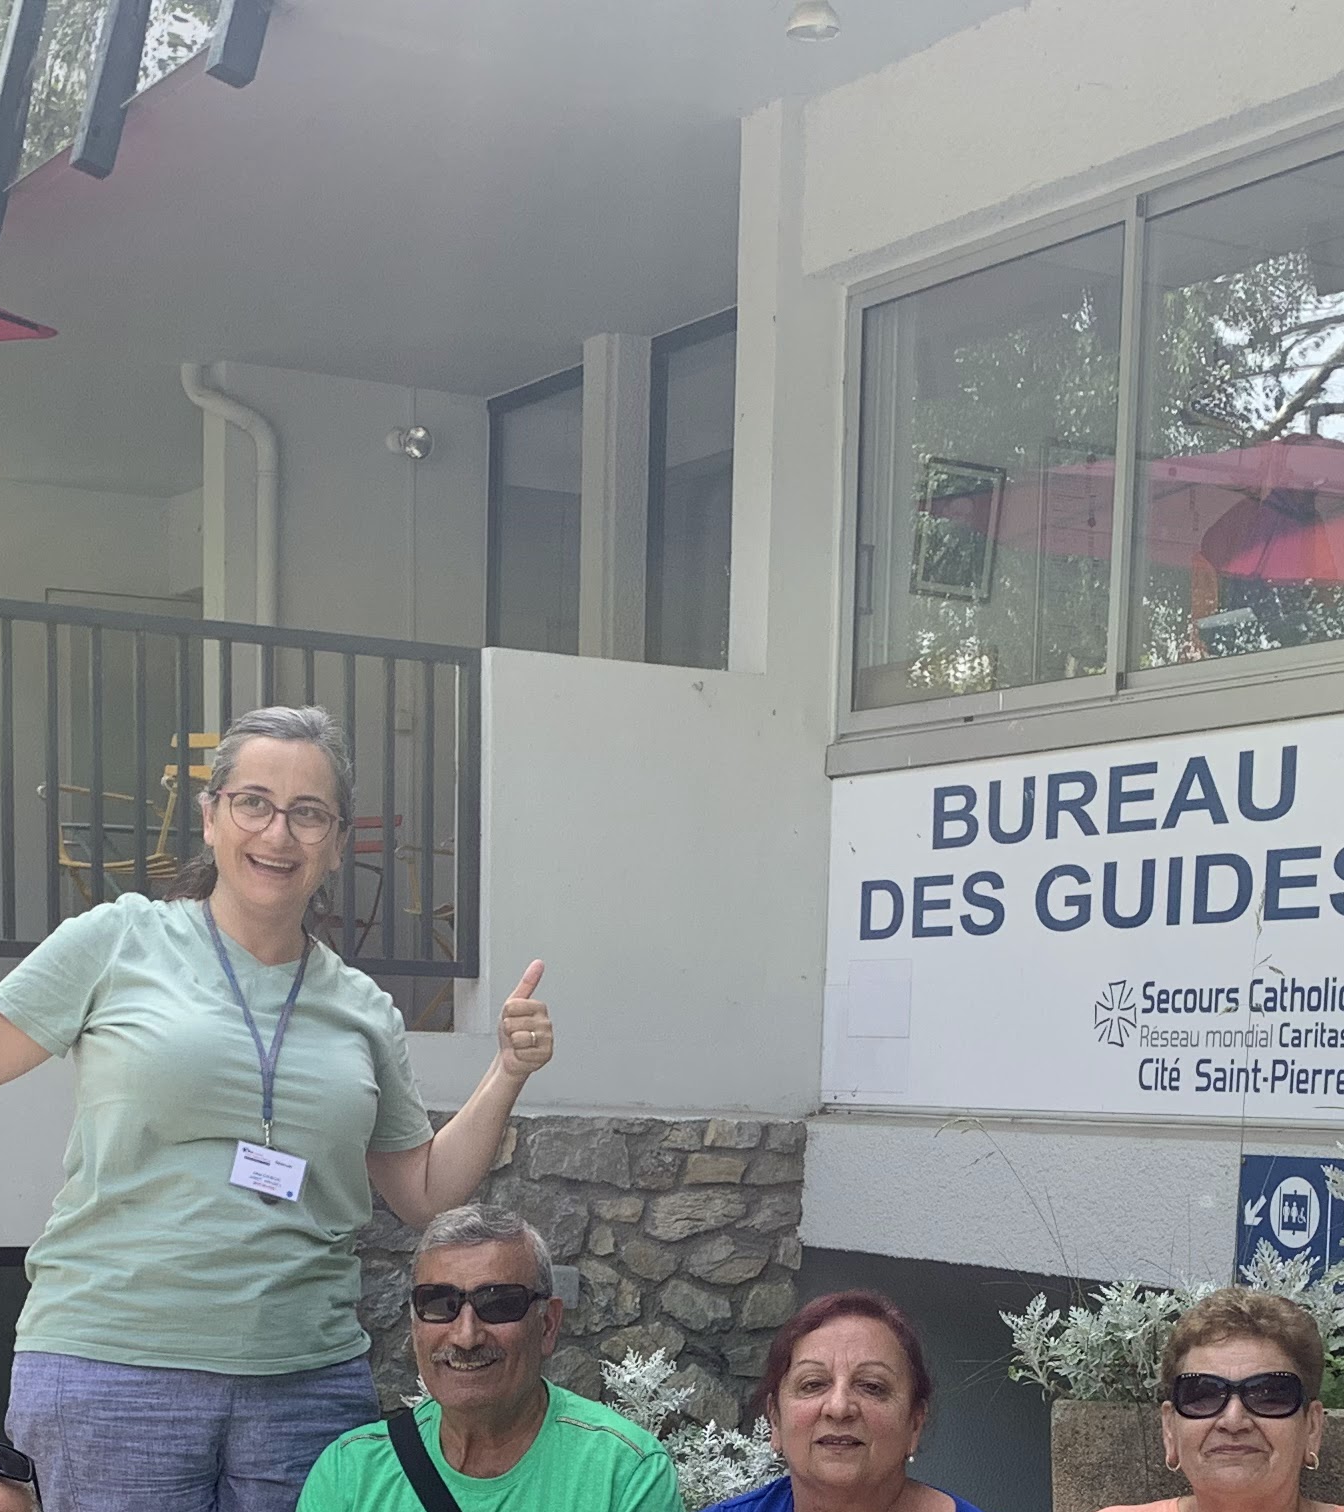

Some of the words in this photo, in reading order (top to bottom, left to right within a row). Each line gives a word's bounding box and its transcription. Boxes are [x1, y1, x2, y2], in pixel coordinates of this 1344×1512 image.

[932, 746, 1298, 850] BUREAU
[860, 871, 1005, 940] DES
[1142, 982, 1239, 1014] Secours
[1140, 1025, 1200, 1049] Réseau
[1205, 1023, 1273, 1049] mondial
[1139, 1058, 1181, 1091] Cité
